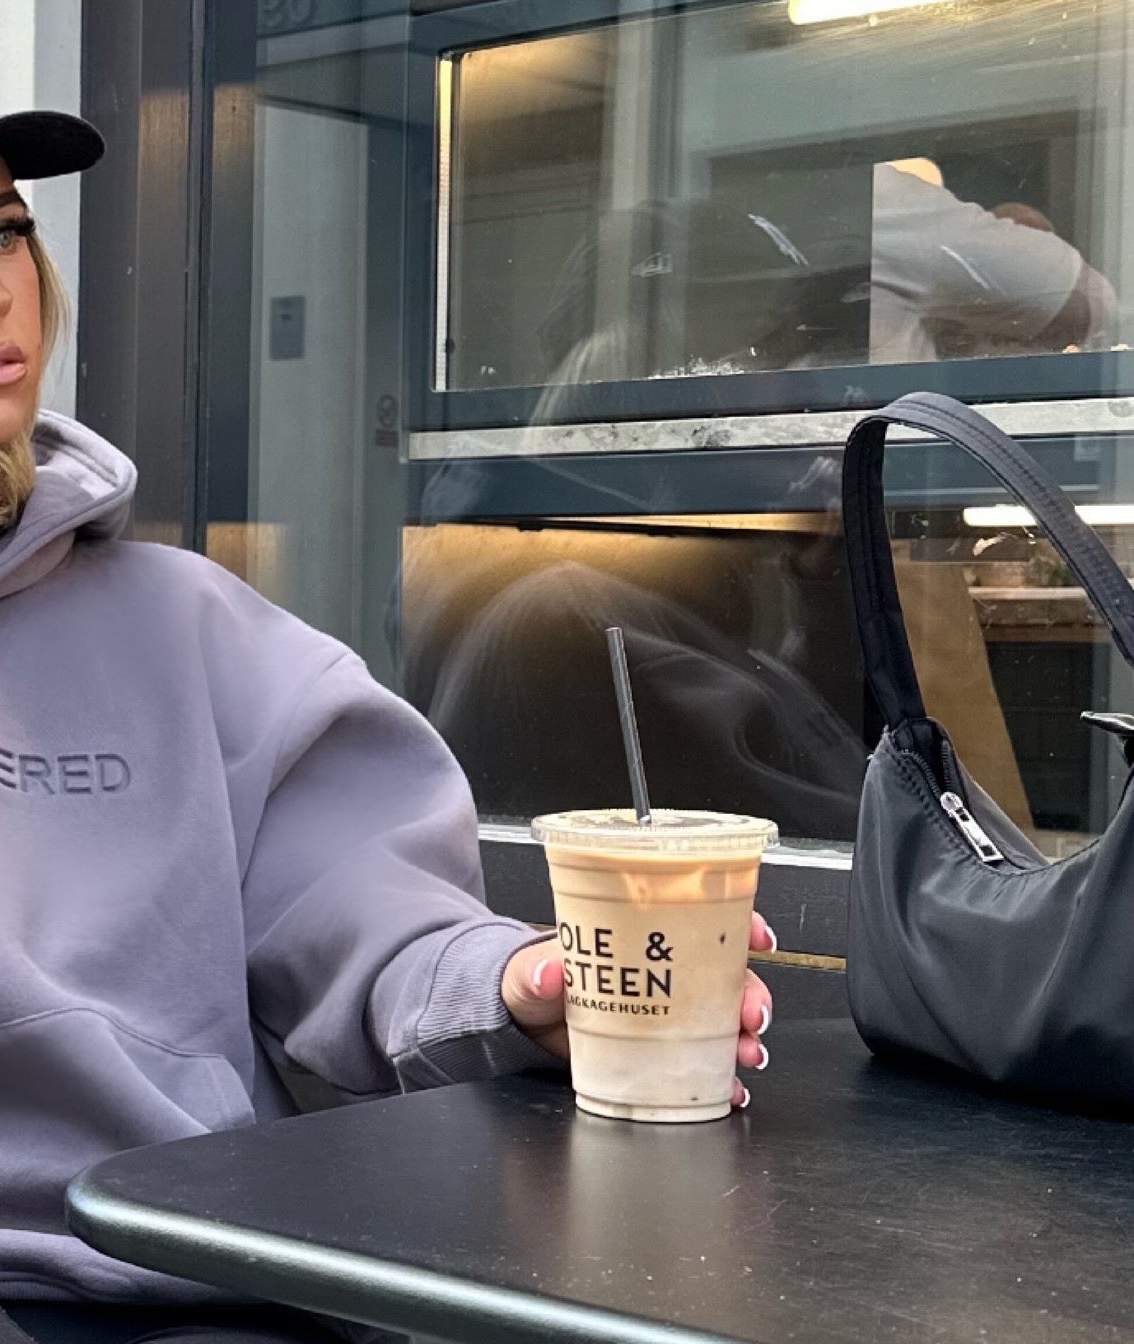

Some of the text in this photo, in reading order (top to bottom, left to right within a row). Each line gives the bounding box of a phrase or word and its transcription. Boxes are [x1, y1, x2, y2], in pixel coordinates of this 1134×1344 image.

[559, 921, 674, 962] OLE &
[563, 957, 672, 998] STEEN
